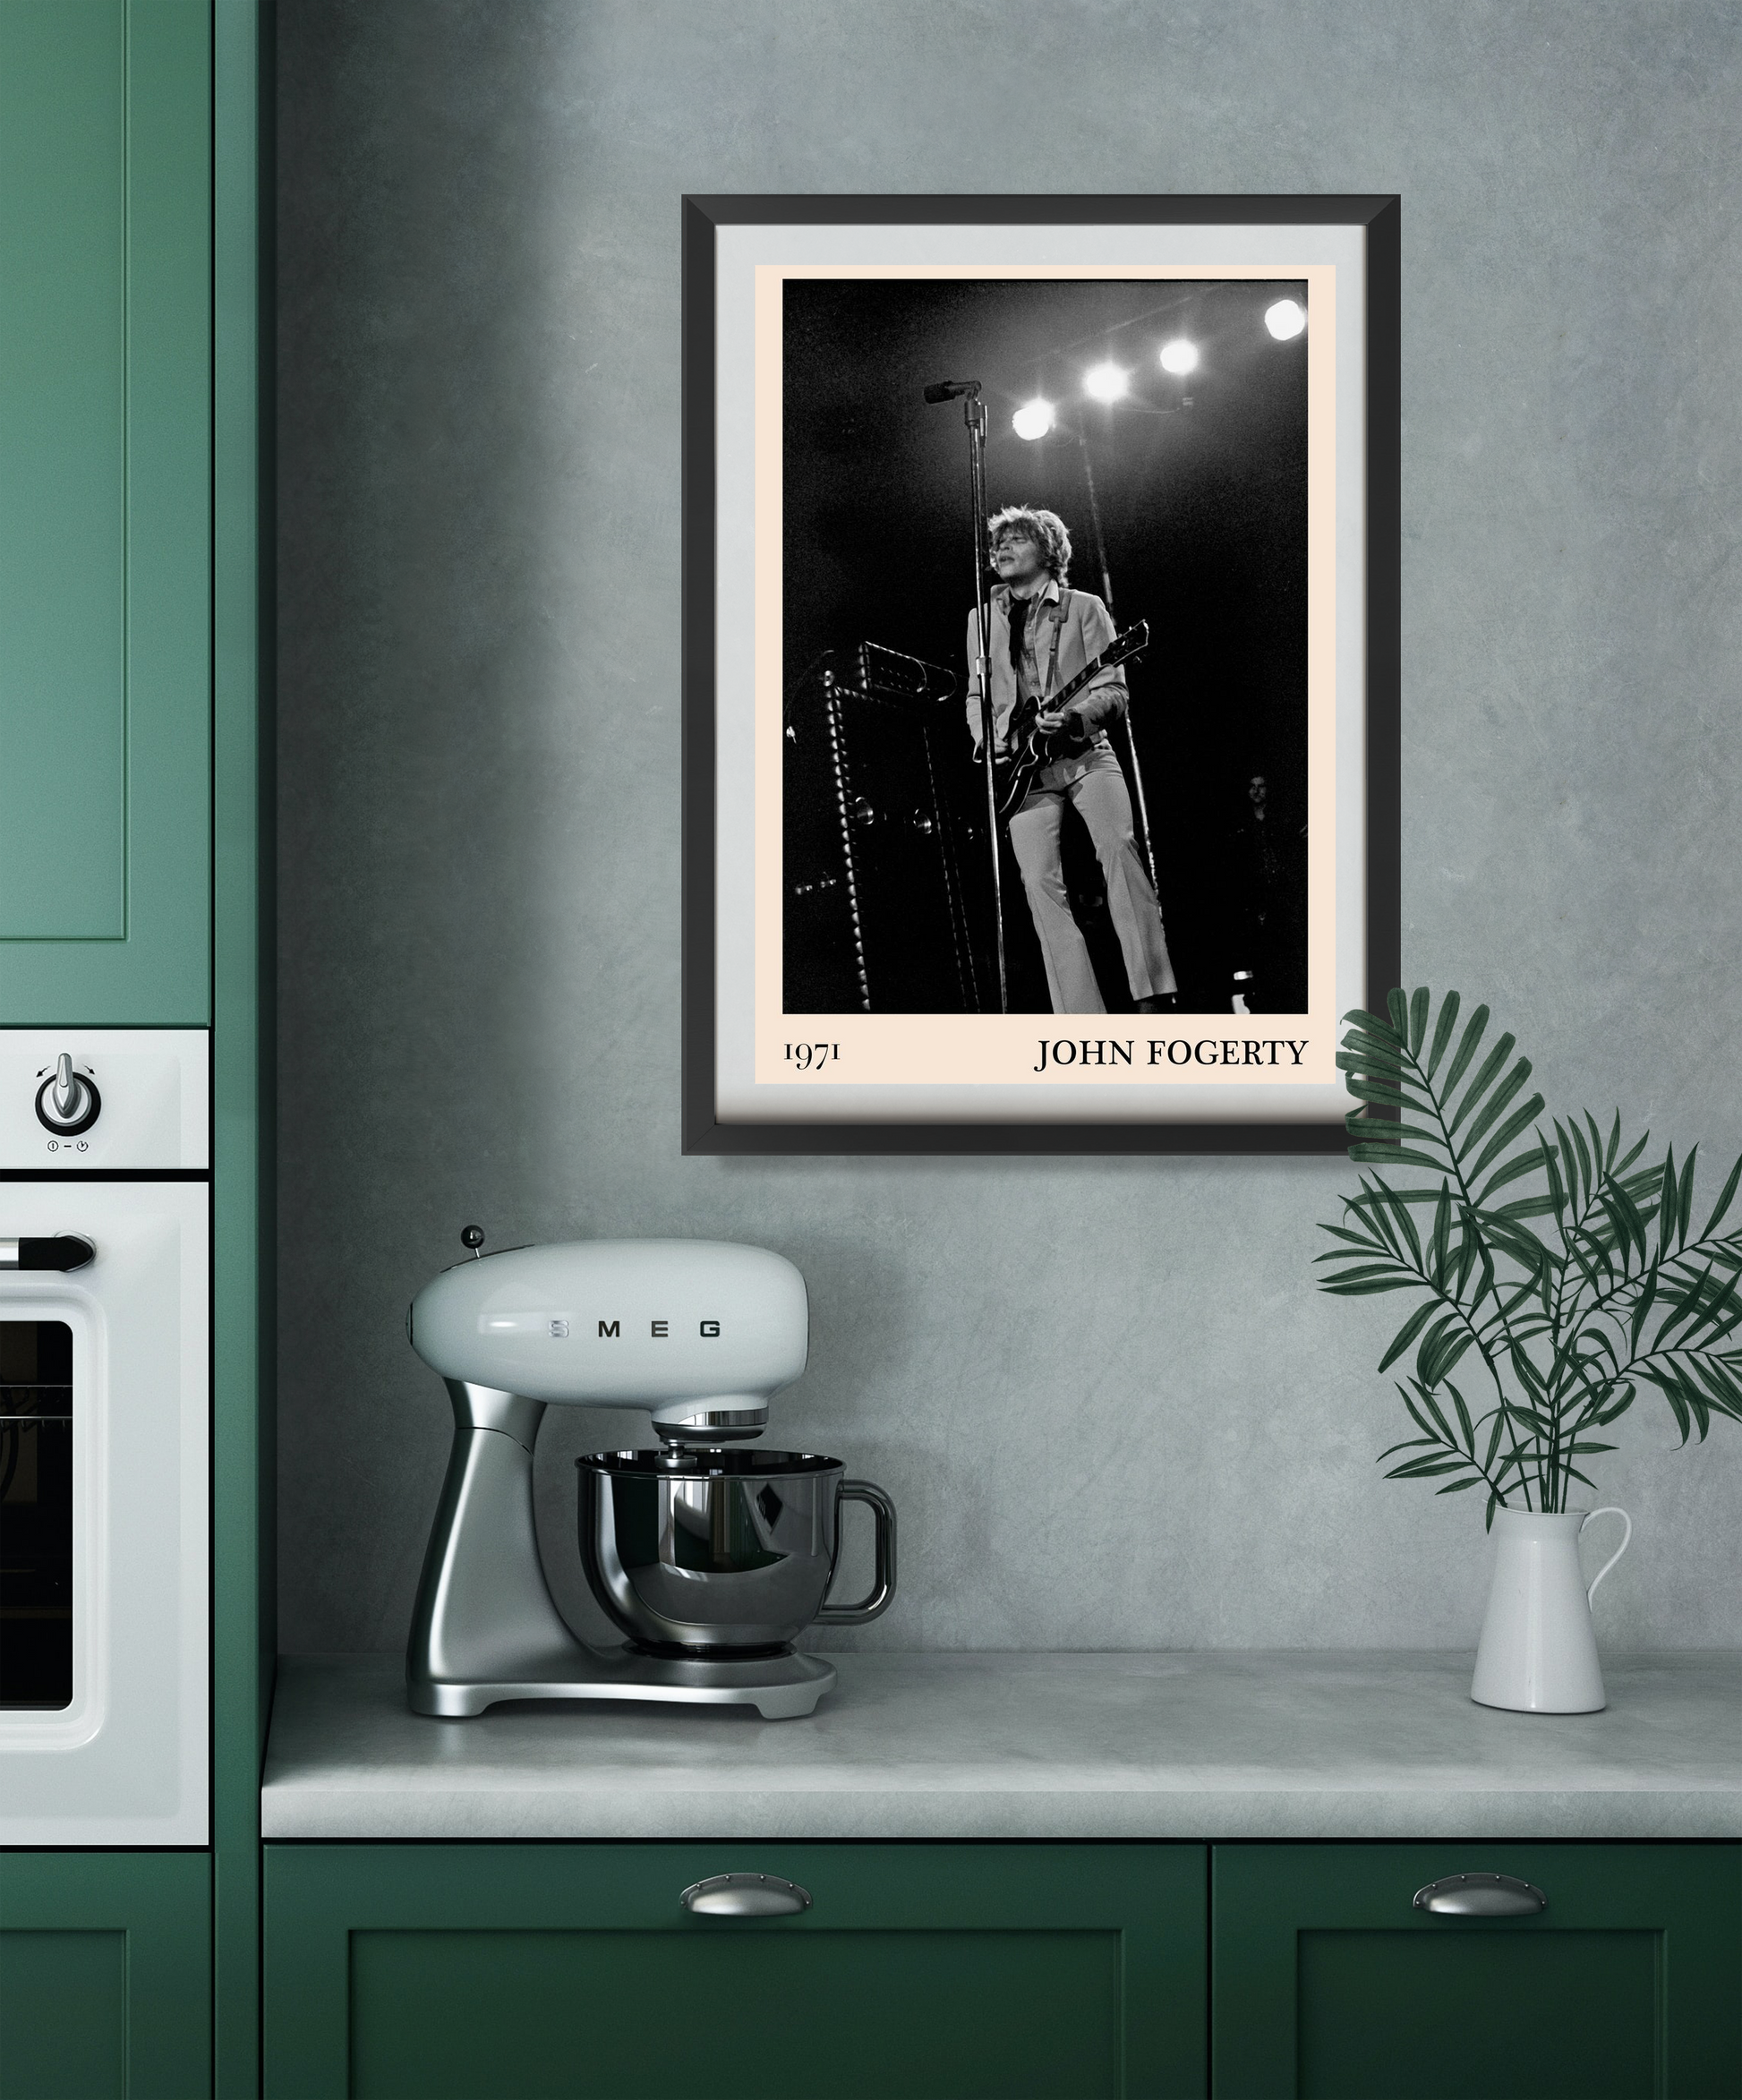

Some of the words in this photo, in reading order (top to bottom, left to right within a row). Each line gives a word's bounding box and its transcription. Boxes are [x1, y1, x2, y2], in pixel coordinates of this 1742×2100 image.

[784, 1044, 840, 1070] 1971
[1034, 1040, 1134, 1071] JOHN
[1147, 1040, 1309, 1065] FOGERTY
[547, 1320, 720, 1338] SMEG
